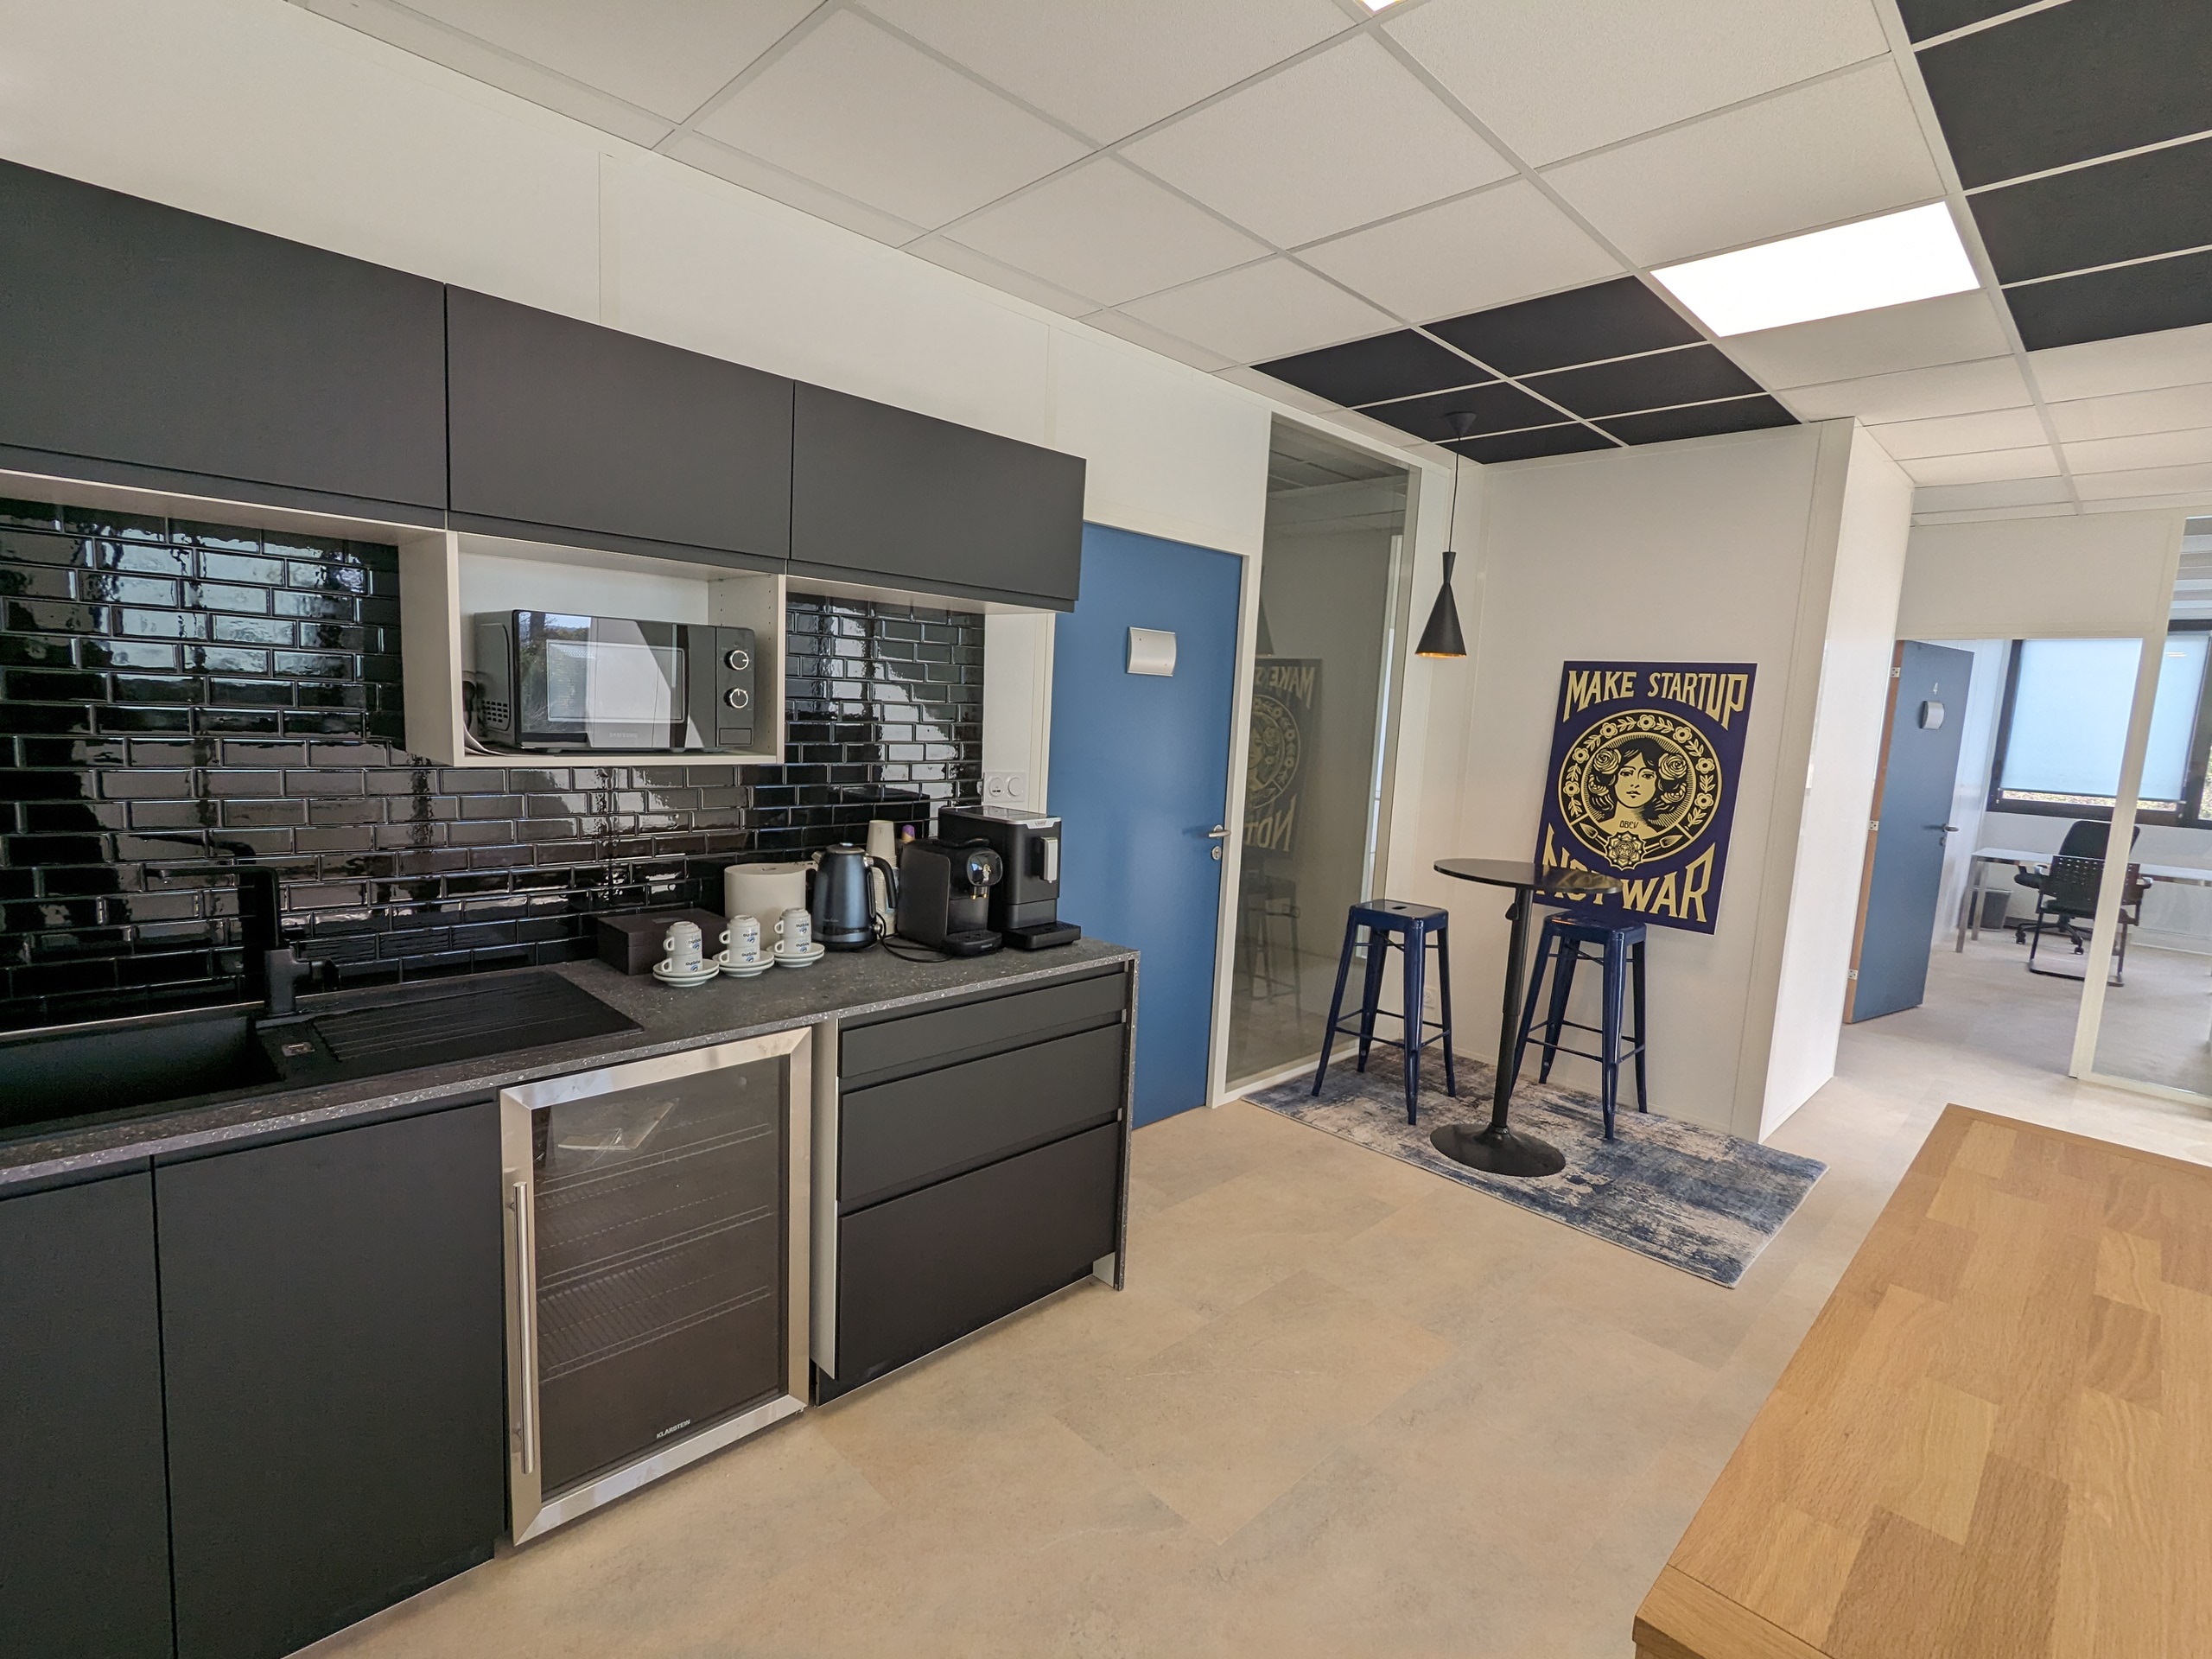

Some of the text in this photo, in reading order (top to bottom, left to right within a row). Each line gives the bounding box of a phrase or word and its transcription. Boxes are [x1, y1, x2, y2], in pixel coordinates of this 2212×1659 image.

[1562, 671, 1749, 731] MAKE STARTUP
[1933, 683, 1938, 695] 4
[1618, 820, 1639, 830] OBEY
[1620, 842, 1716, 923] WAR
